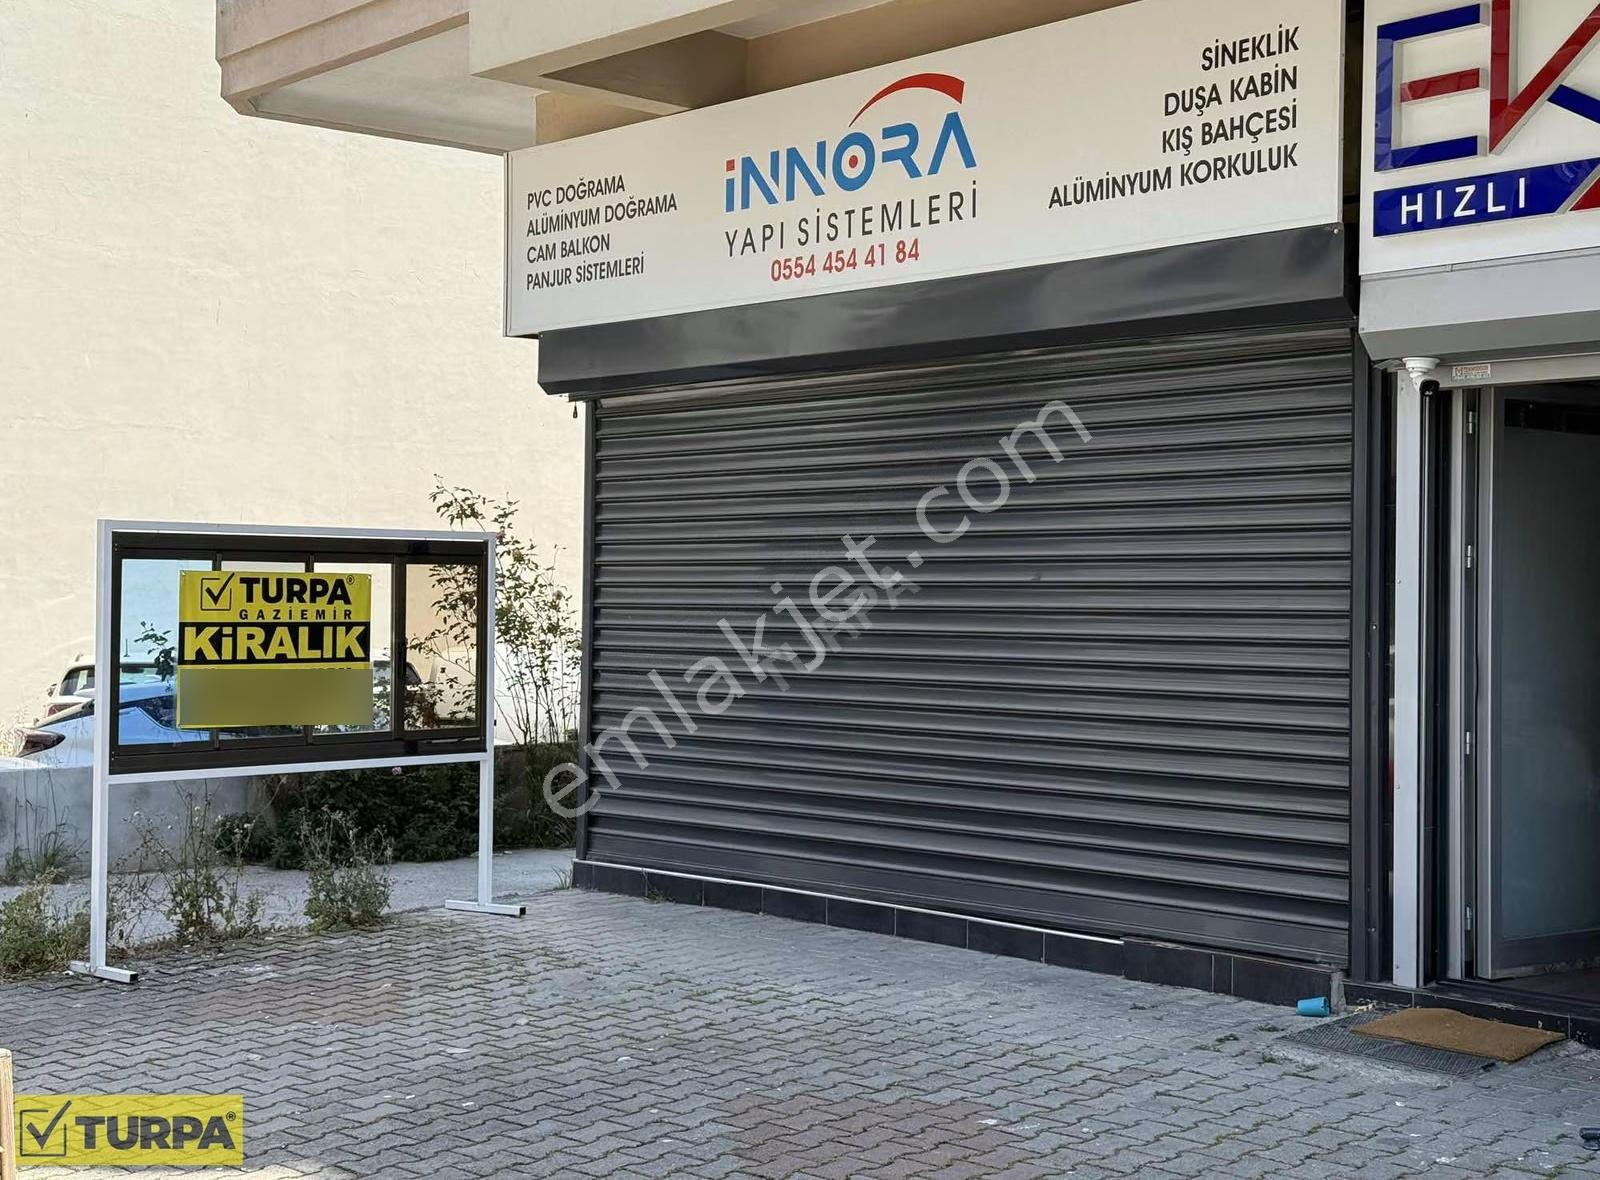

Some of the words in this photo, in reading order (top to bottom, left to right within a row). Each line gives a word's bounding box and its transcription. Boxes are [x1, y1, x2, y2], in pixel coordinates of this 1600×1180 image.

[1201, 23, 1300, 71] SİNEKLİK
[1163, 83, 1223, 117] DUŞA
[1229, 63, 1298, 103] KABİN
[1162, 125, 1193, 156] KIŞ
[1201, 97, 1297, 146] BAHÇESİ
[527, 189, 552, 210] PVC
[556, 174, 625, 205] DOĞRAMA
[1048, 166, 1172, 209] ALÜMİNYUM
[1180, 142, 1298, 187] KORKULUK
[526, 206, 600, 238] ALÜMİNYUM
[604, 193, 678, 223] DOĞRAMA
[725, 221, 784, 258] YAPI
[797, 180, 977, 247] SİSTEMLERİ
[1401, 177, 1526, 225] HIZLI
[526, 267, 572, 291] PANJUR
[575, 250, 645, 283] SİSTEMLERİ
[527, 242, 556, 264] CAM
[560, 233, 610, 259] BALKON
[770, 254, 816, 282] 0554
[822, 248, 857, 273] 454
[864, 243, 886, 267] 41
[895, 238, 920, 264] 84
[239, 577, 353, 605] TURPA
[239, 606, 352, 620] GAZİEMİR
